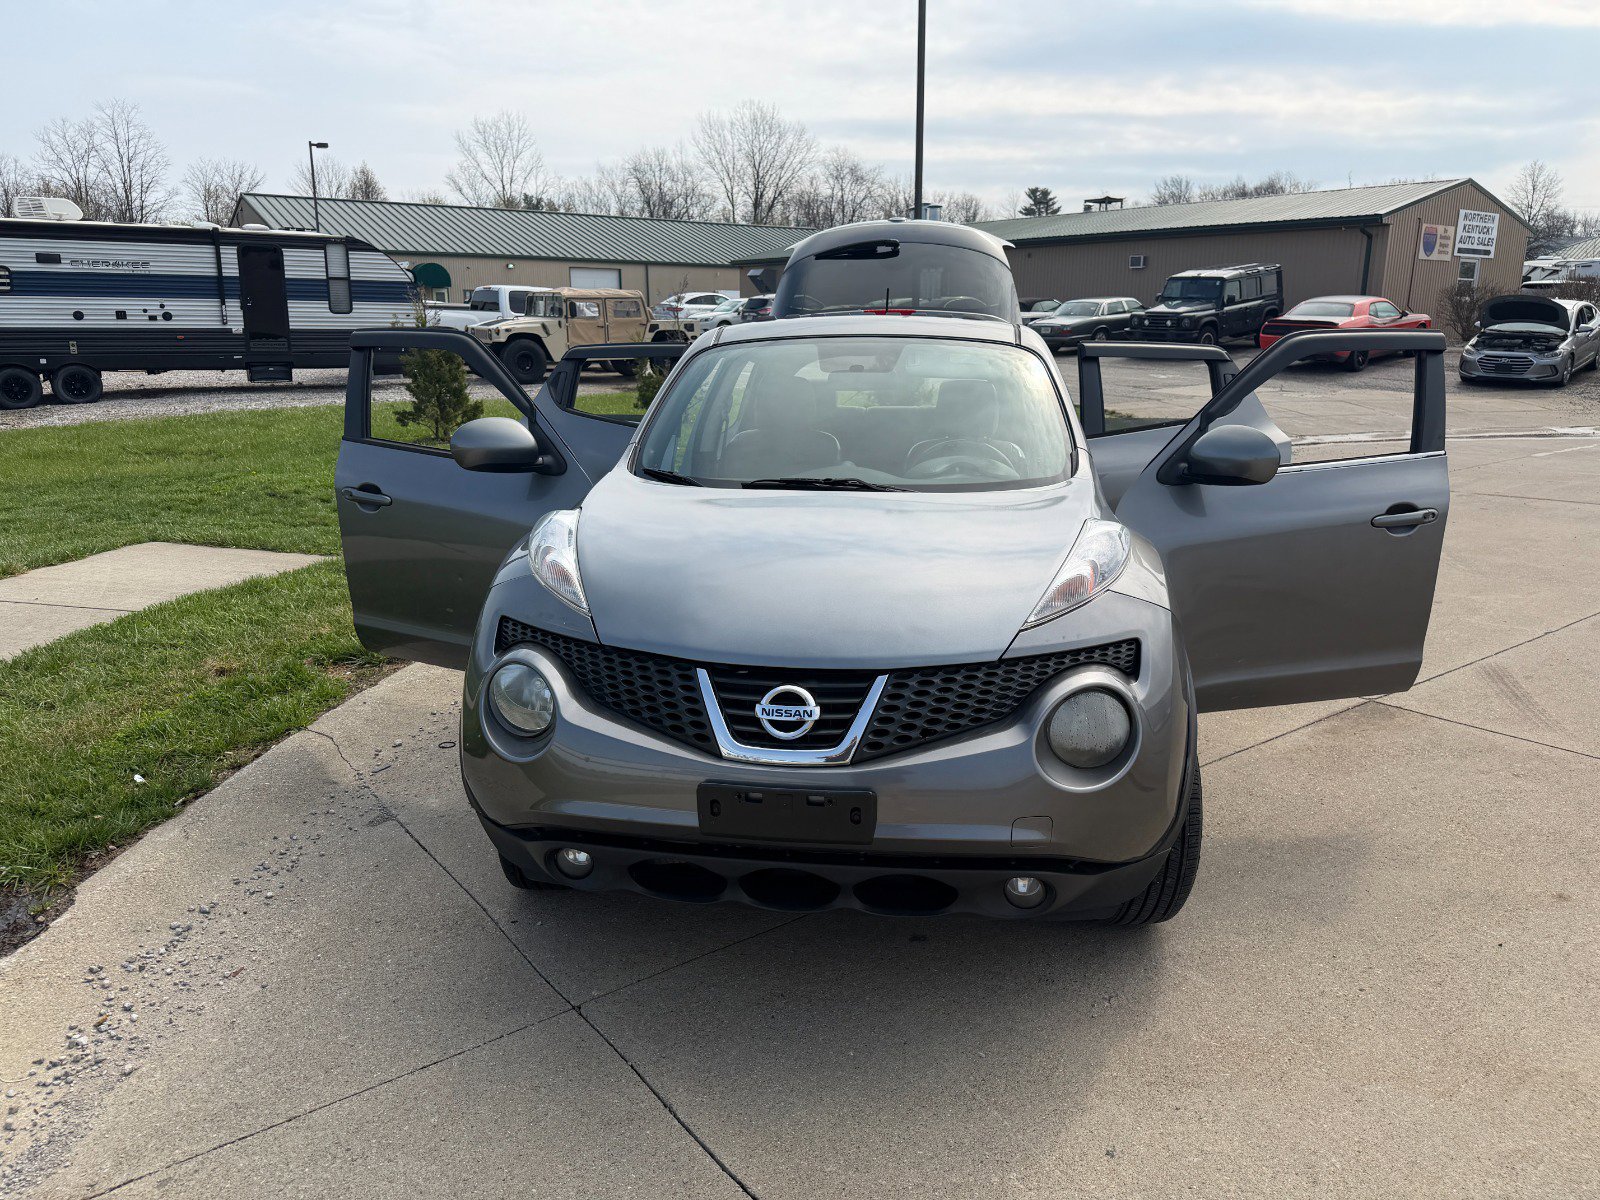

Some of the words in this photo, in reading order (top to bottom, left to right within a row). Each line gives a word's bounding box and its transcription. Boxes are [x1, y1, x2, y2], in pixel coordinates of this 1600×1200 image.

[1463, 211, 1496, 224] NORTHERN
[1462, 223, 1494, 235] KENTUCKY
[1458, 234, 1476, 246] AUTO
[1476, 236, 1495, 247] SALES
[69, 260, 151, 269] CHEROKEE
[761, 707, 813, 718] NISSAN
